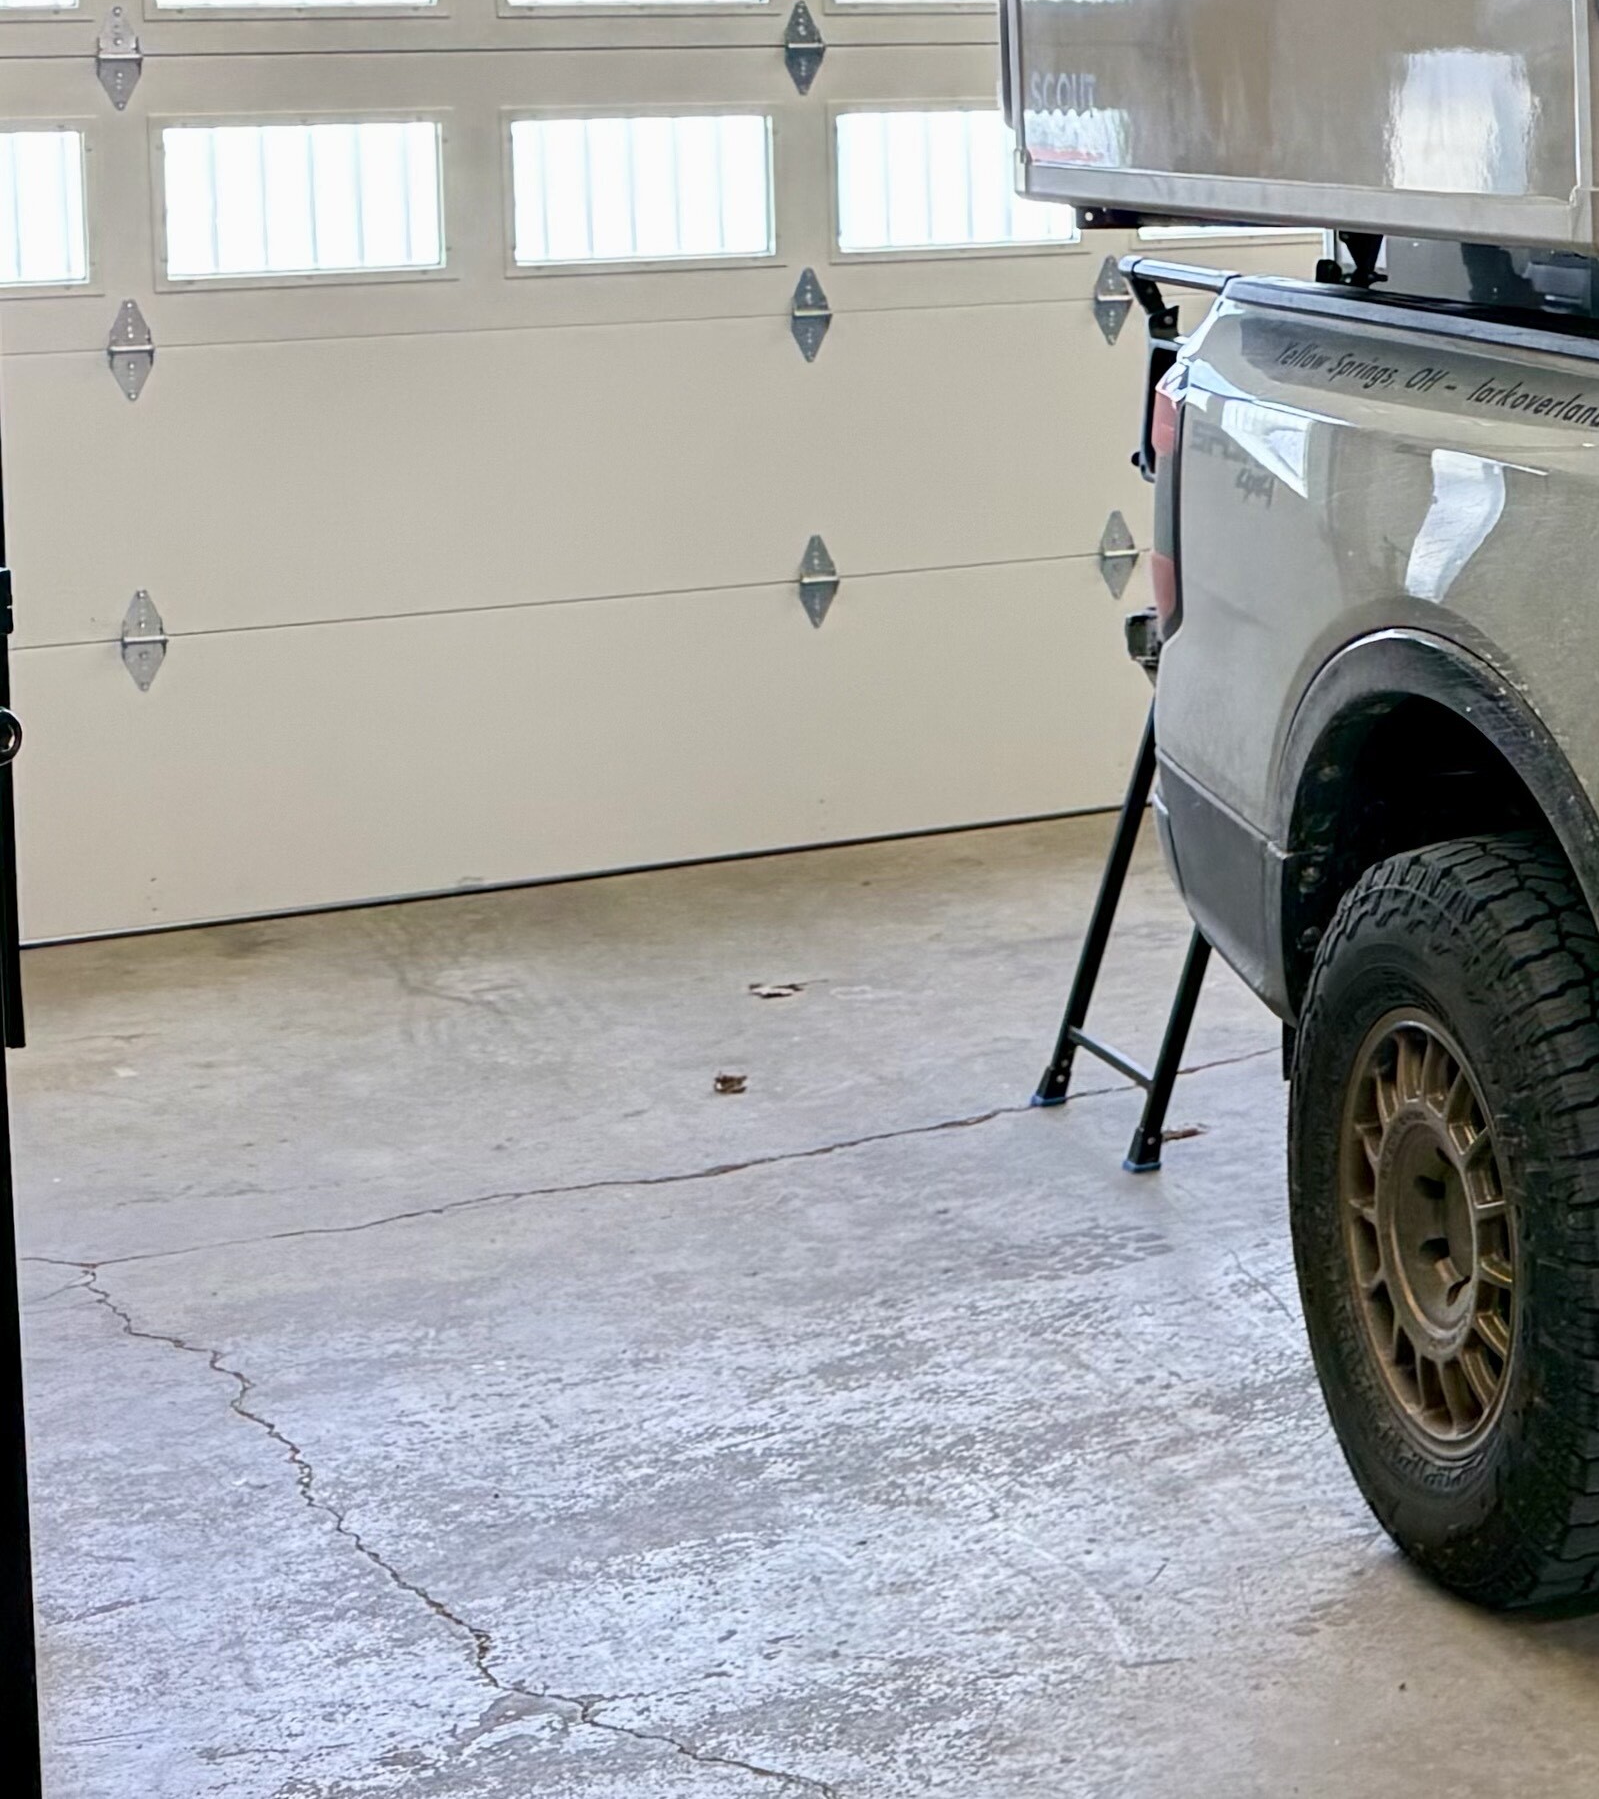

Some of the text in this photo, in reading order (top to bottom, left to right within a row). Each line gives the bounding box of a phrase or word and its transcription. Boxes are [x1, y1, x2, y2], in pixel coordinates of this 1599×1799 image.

[1275, 342, 1331, 371] Yellow
[1327, 352, 1398, 390] Springs,
[1404, 367, 1450, 393] OH
